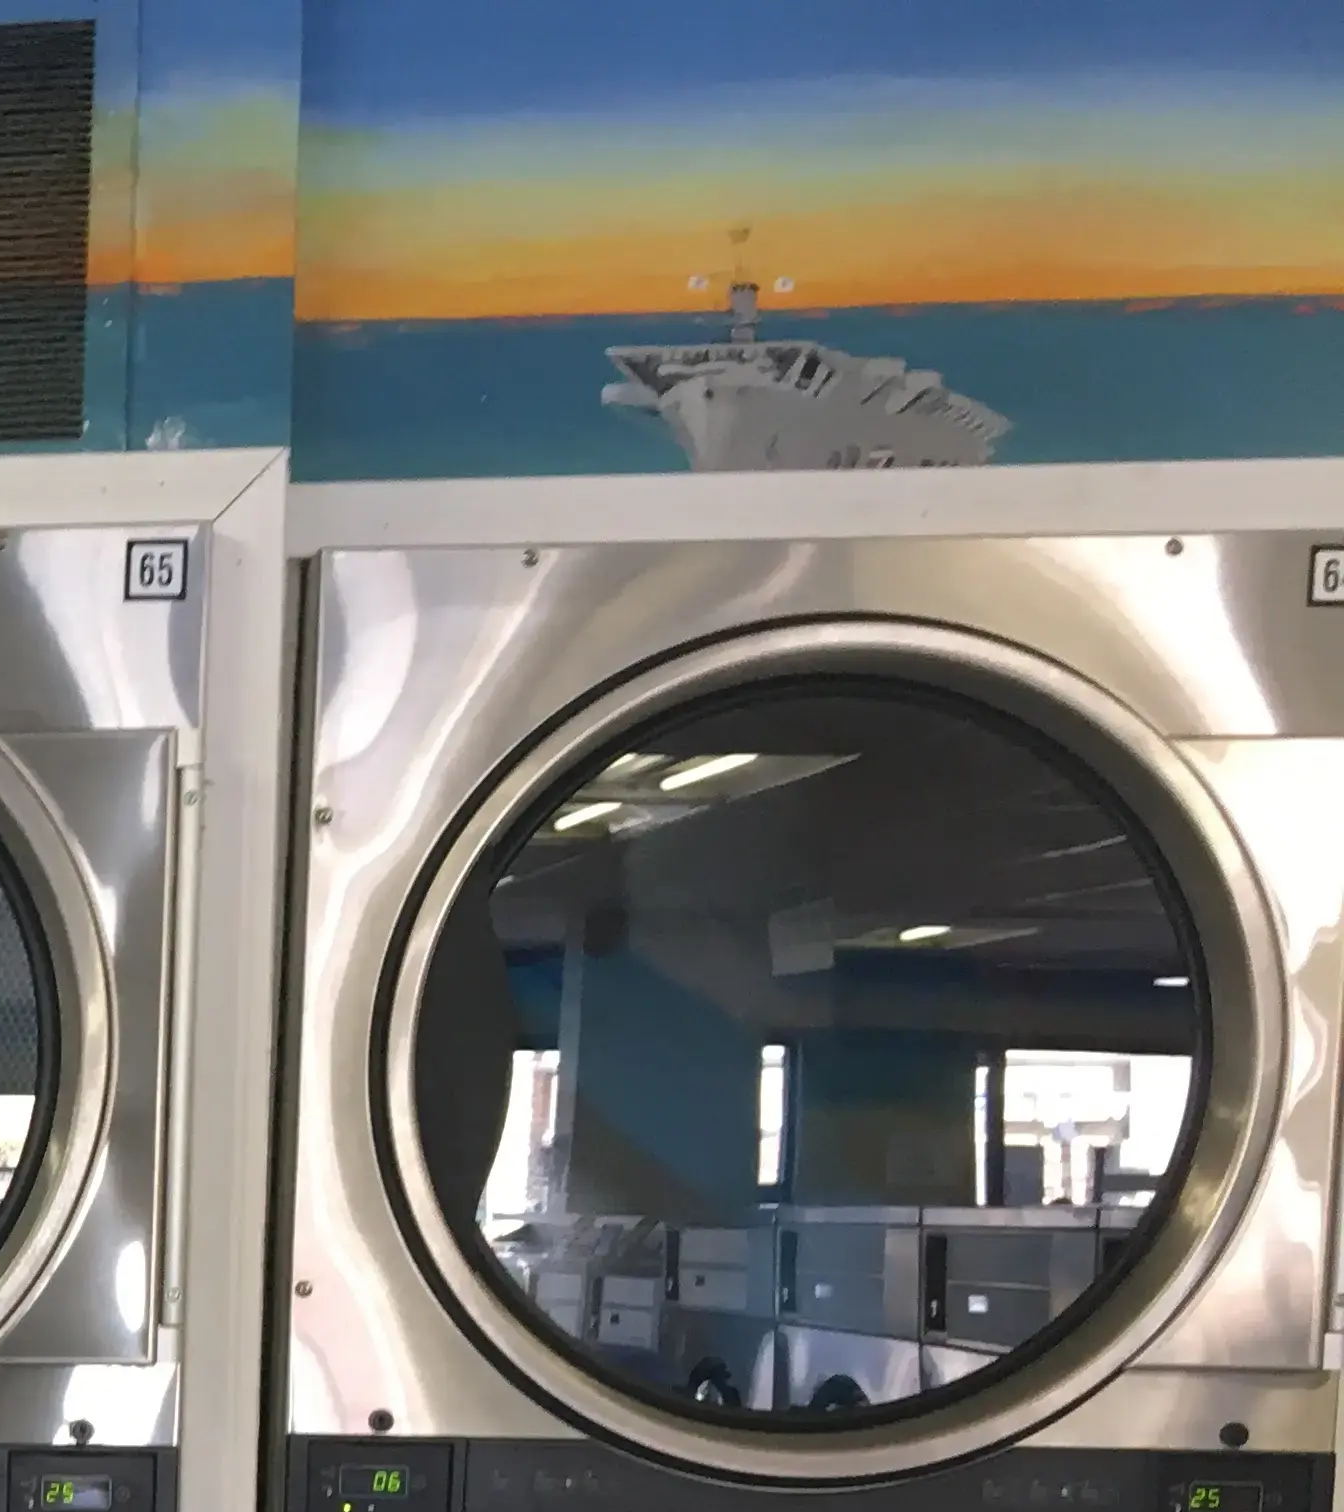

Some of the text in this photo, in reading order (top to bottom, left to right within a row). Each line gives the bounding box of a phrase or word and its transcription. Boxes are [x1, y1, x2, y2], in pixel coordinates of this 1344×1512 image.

[139, 551, 173, 587] 65
[1323, 558, 1344, 593] 6
[373, 1471, 401, 1493] 06
[1190, 1488, 1220, 1508] 25
